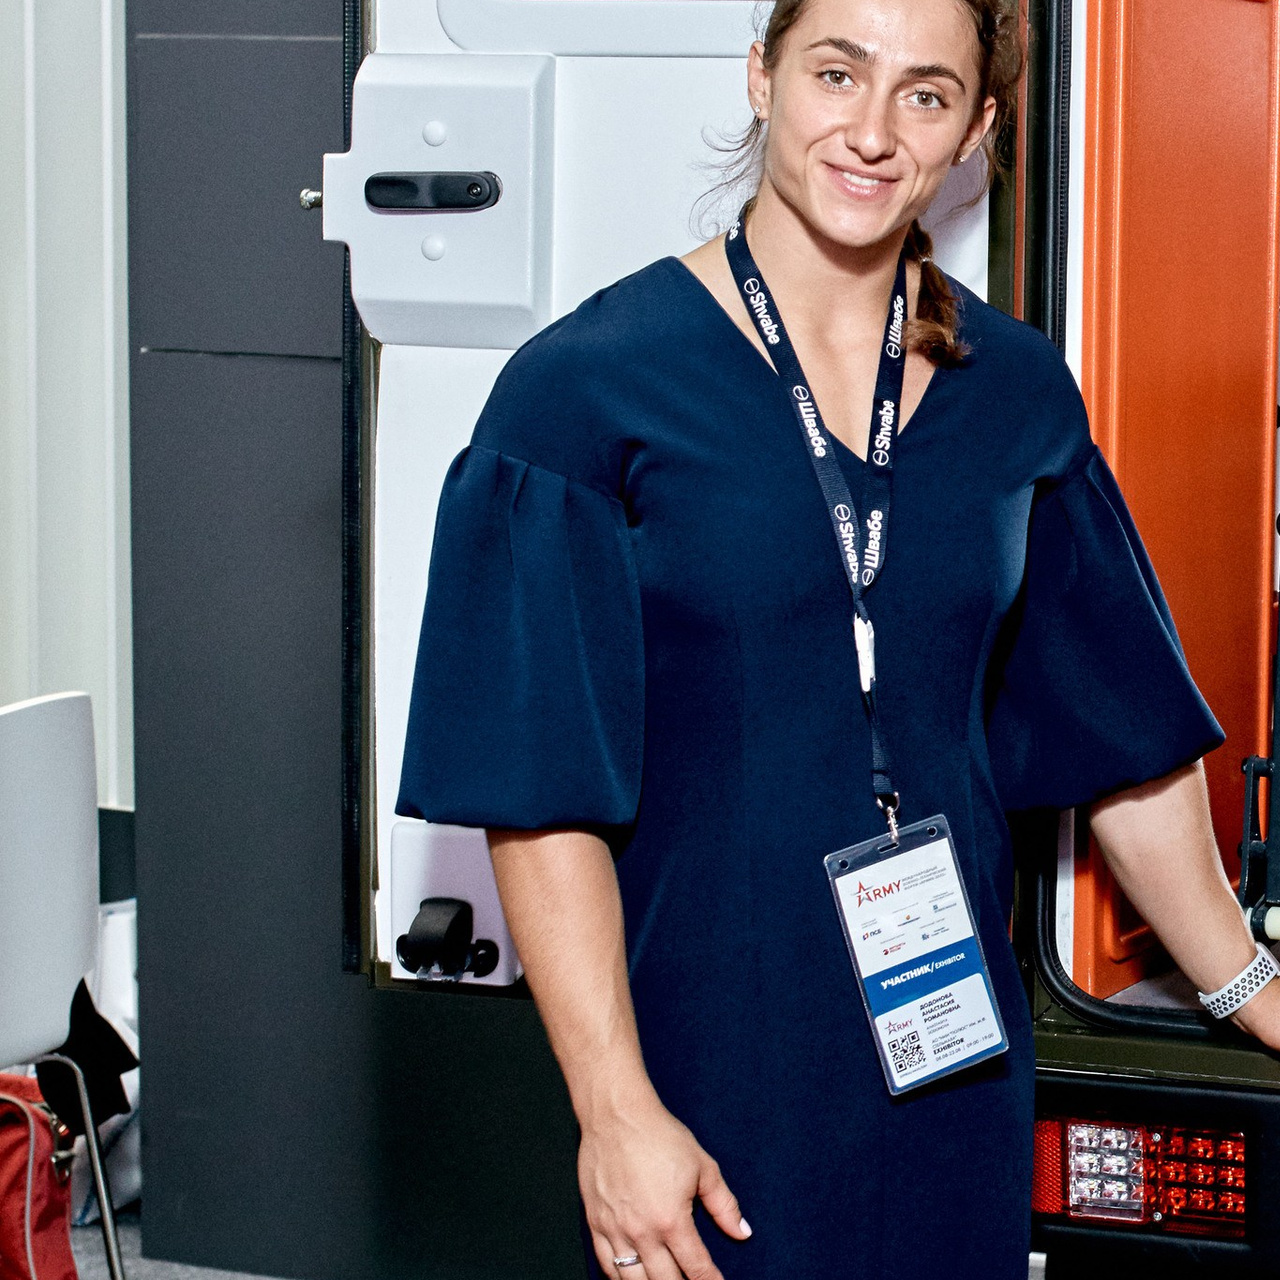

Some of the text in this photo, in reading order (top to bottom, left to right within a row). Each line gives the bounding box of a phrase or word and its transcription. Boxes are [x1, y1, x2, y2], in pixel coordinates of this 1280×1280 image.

[750, 291, 780, 345] Shvabe
[798, 401, 826, 458] Швабе
[875, 399, 895, 451] Shvabe
[864, 509, 883, 569] Швабе
[856, 880, 900, 908] ARMY
[924, 1004, 961, 1023] РОМАНОВНА
[933, 1038, 965, 1055] EXHIBITOR
